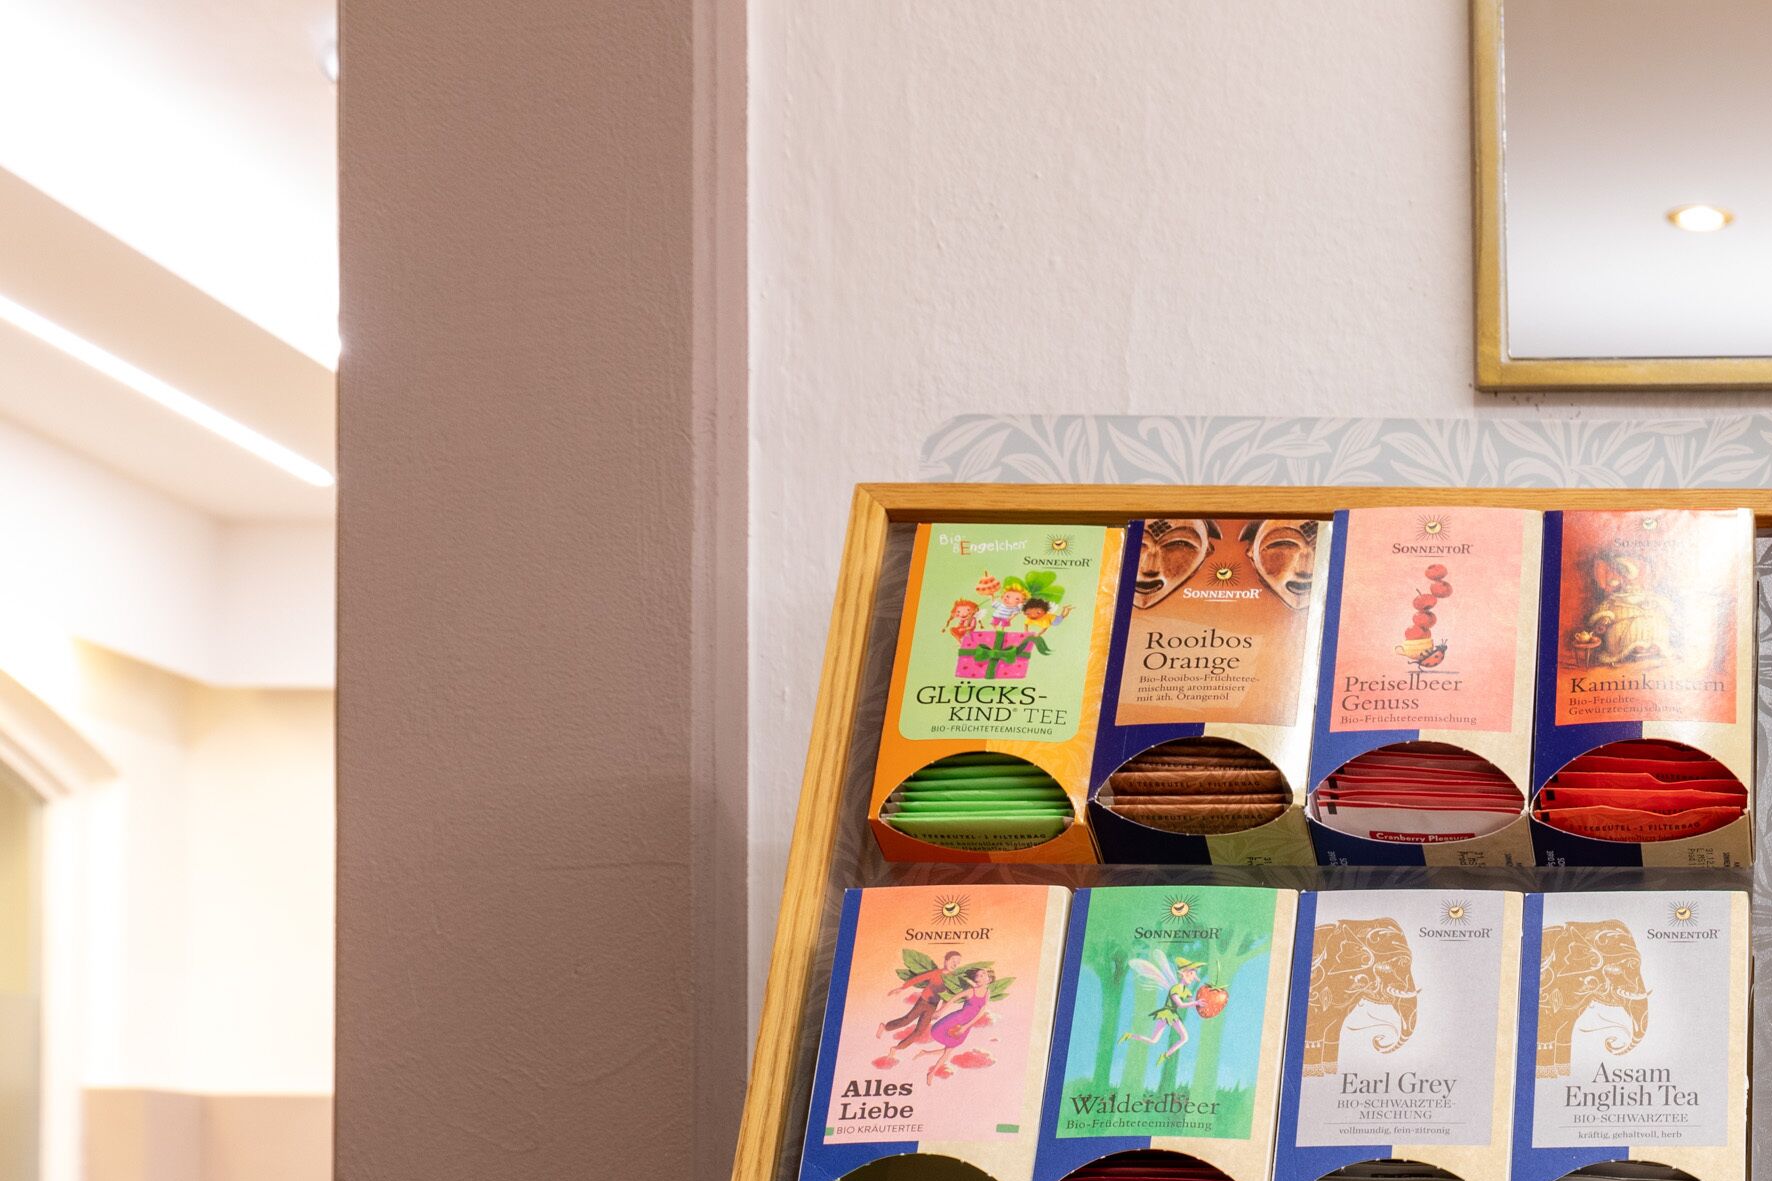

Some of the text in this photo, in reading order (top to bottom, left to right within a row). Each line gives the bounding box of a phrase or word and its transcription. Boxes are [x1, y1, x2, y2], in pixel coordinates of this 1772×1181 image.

[1145, 628, 1253, 649] Rooibos
[1143, 652, 1240, 675] Orange
[1138, 684, 1246, 693] mischung aromatisiert
[1344, 673, 1462, 692] Preiselbeer
[917, 681, 1047, 705] GLÜCKS-
[1176, 693, 1229, 702] Orangenöl
[1342, 694, 1419, 711] Genuss
[1024, 708, 1067, 725] TEE
[1340, 713, 1477, 725] Bio-Früchteteemischung
[931, 725, 1053, 735] BIO-FRÜCHTETEEMISCHUNG
[1376, 832, 1426, 843] Cranberry
[1592, 1062, 1671, 1083] Assam
[841, 1080, 913, 1097] Alles
[1340, 1072, 1457, 1099] Earl Grey
[1071, 1093, 1220, 1115] Walderdbeer
[1337, 1099, 1456, 1109] BIO-SCHWARZTEE-
[1565, 1085, 1699, 1112] English Tea
[838, 1102, 914, 1120] Liebe
[1359, 1110, 1432, 1120] MISCHUNG
[1573, 1114, 1688, 1123] BIO-SCHWARZTEE
[836, 1123, 924, 1135] BIO KRÄUTERTEE
[1066, 1118, 1212, 1131] Bio-Früchteteemischung
[1339, 1125, 1450, 1136] vollmundig, fein-zitronig
[1578, 1130, 1682, 1140] kräftig, gehaltvoll, herb
